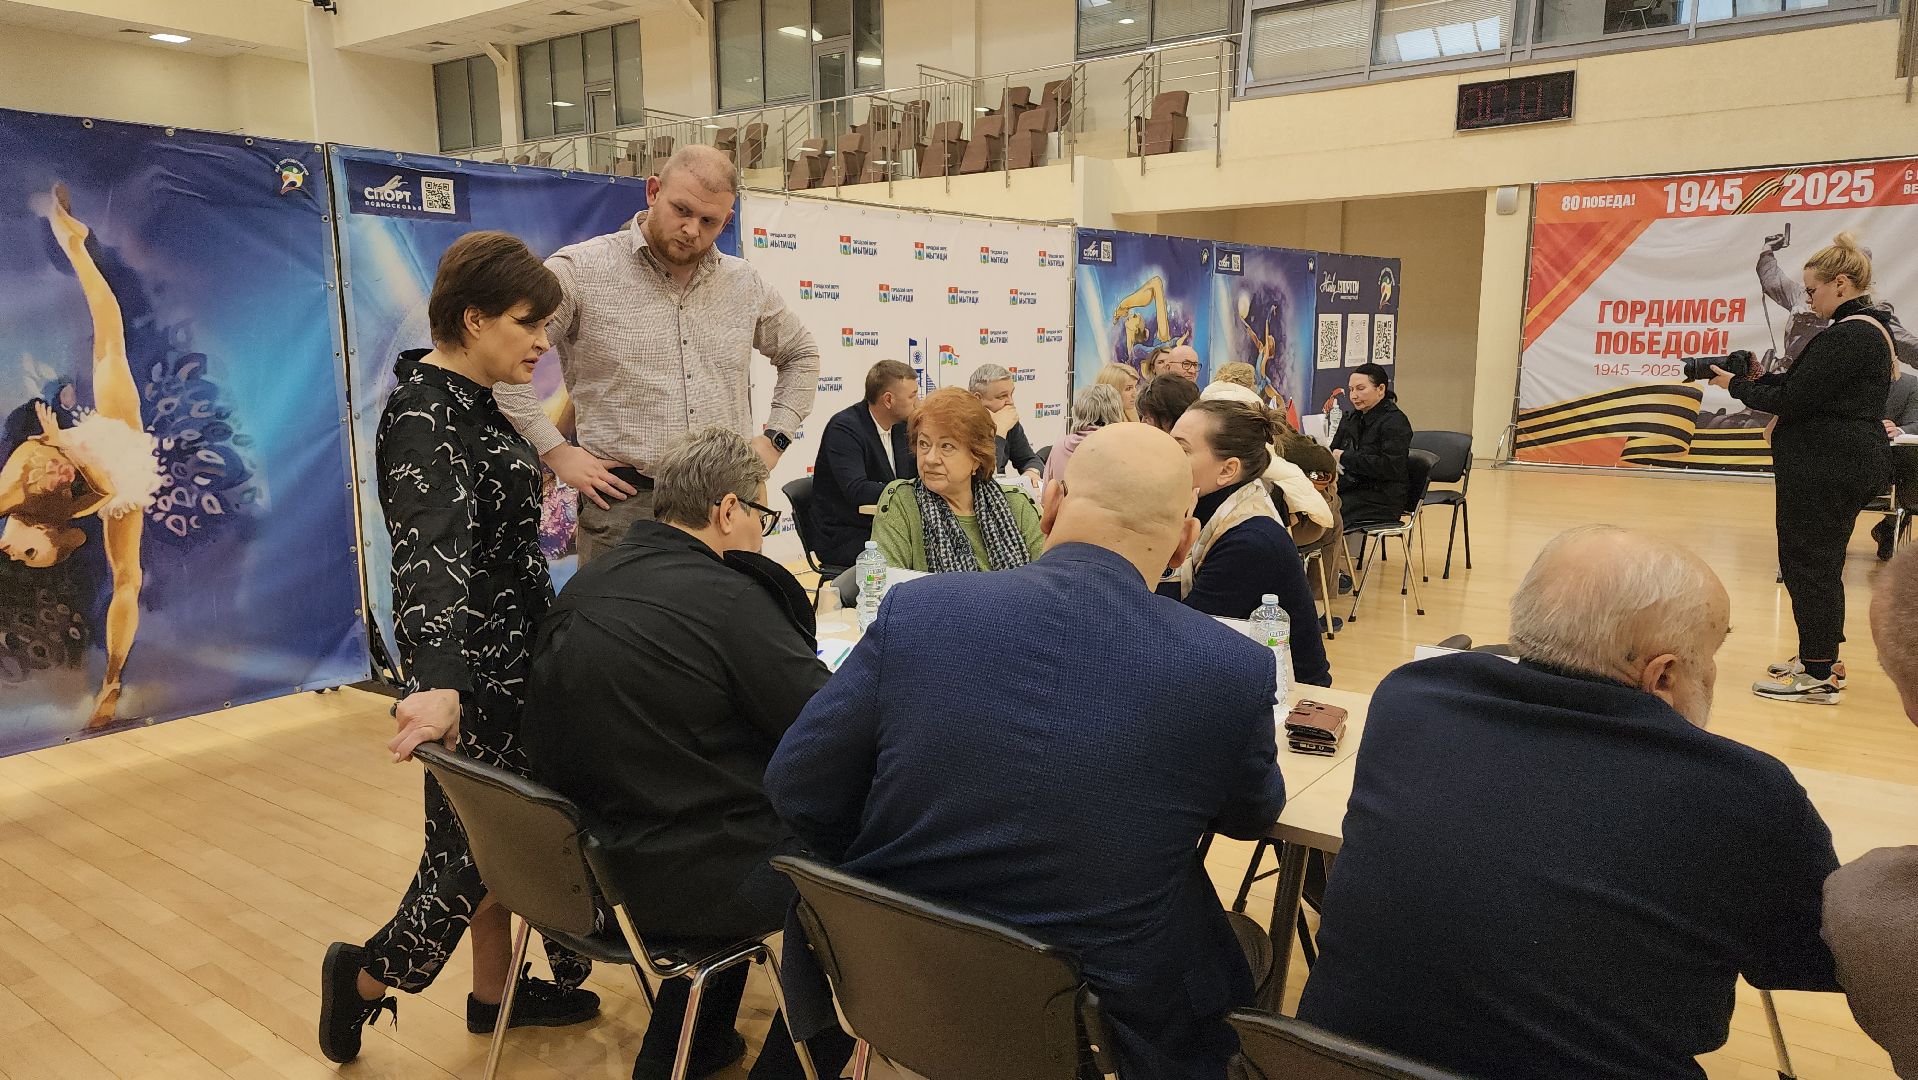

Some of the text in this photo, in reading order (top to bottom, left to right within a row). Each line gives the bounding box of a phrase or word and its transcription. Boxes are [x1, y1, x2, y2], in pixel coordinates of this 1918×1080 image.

[364, 187, 412, 204] СПОРТ
[1562, 194, 1636, 211] 80 ПОБЕДА!
[1664, 168, 1875, 214] 1945 2025
[1598, 298, 1746, 327] ГОРДИМСЯ
[1595, 328, 1729, 359] ПОБЕДОЙ!
